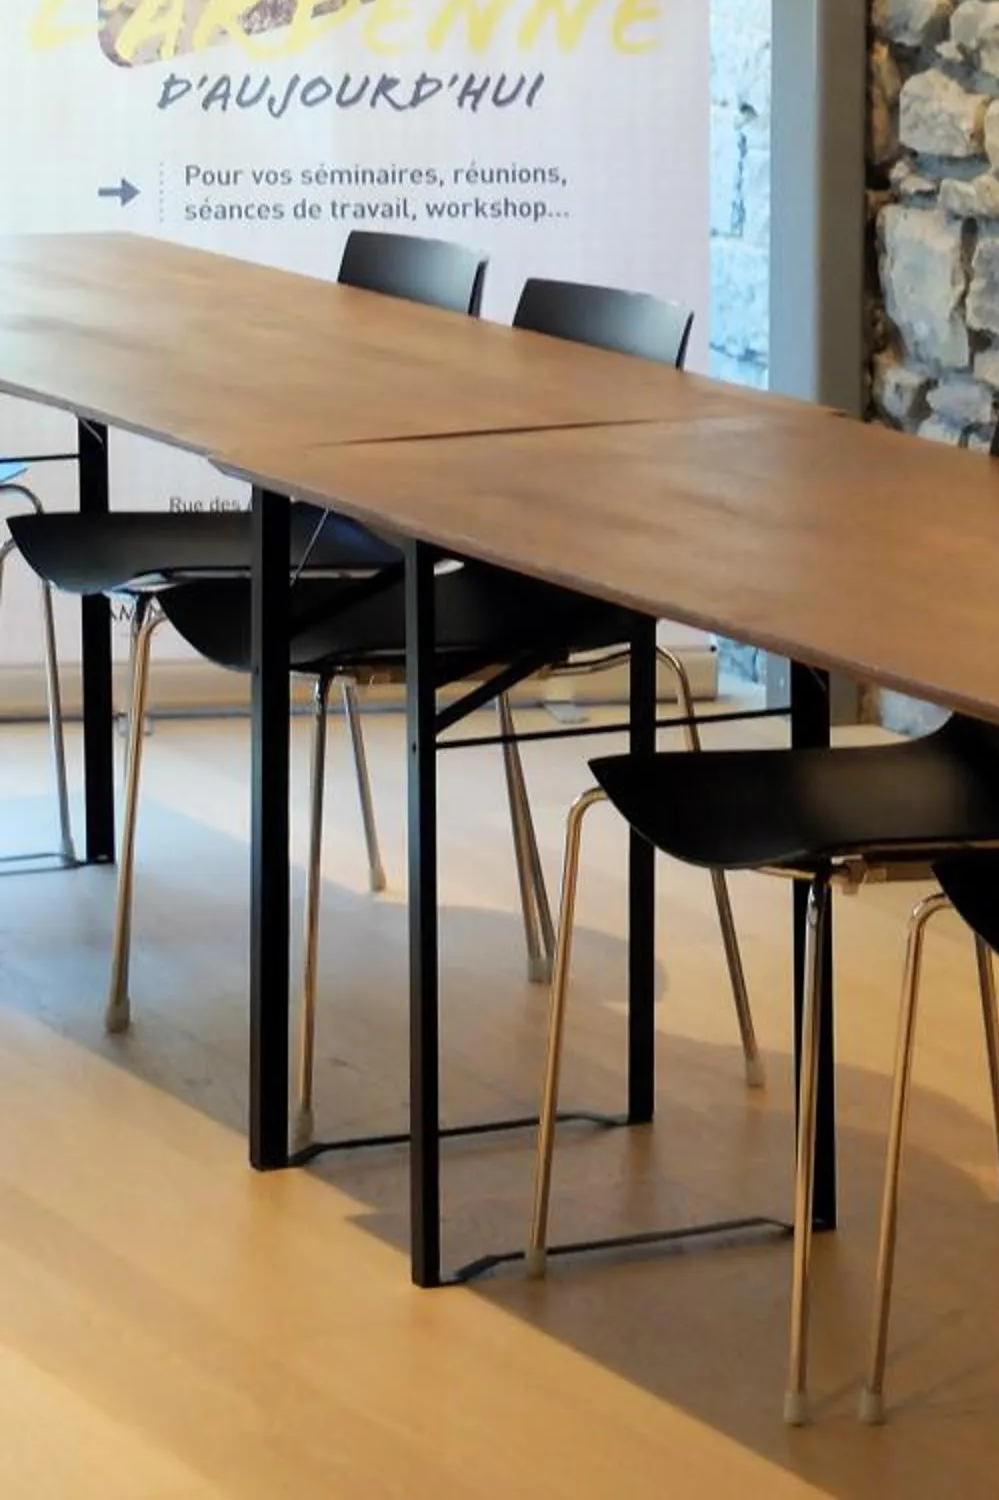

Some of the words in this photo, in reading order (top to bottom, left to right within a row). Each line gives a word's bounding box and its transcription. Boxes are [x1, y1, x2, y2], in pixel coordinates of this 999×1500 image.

[157, 71, 545, 119] D'AUJOURD'HUI
[185, 164, 243, 187] Pour
[252, 168, 293, 186] vos
[300, 162, 445, 188] séminaires,
[453, 159, 568, 187] réunions,
[184, 198, 285, 221] séances
[293, 199, 322, 220] de
[330, 197, 418, 222] travail,
[425, 197, 571, 223] workshop...
[169, 495, 203, 512] Rue
